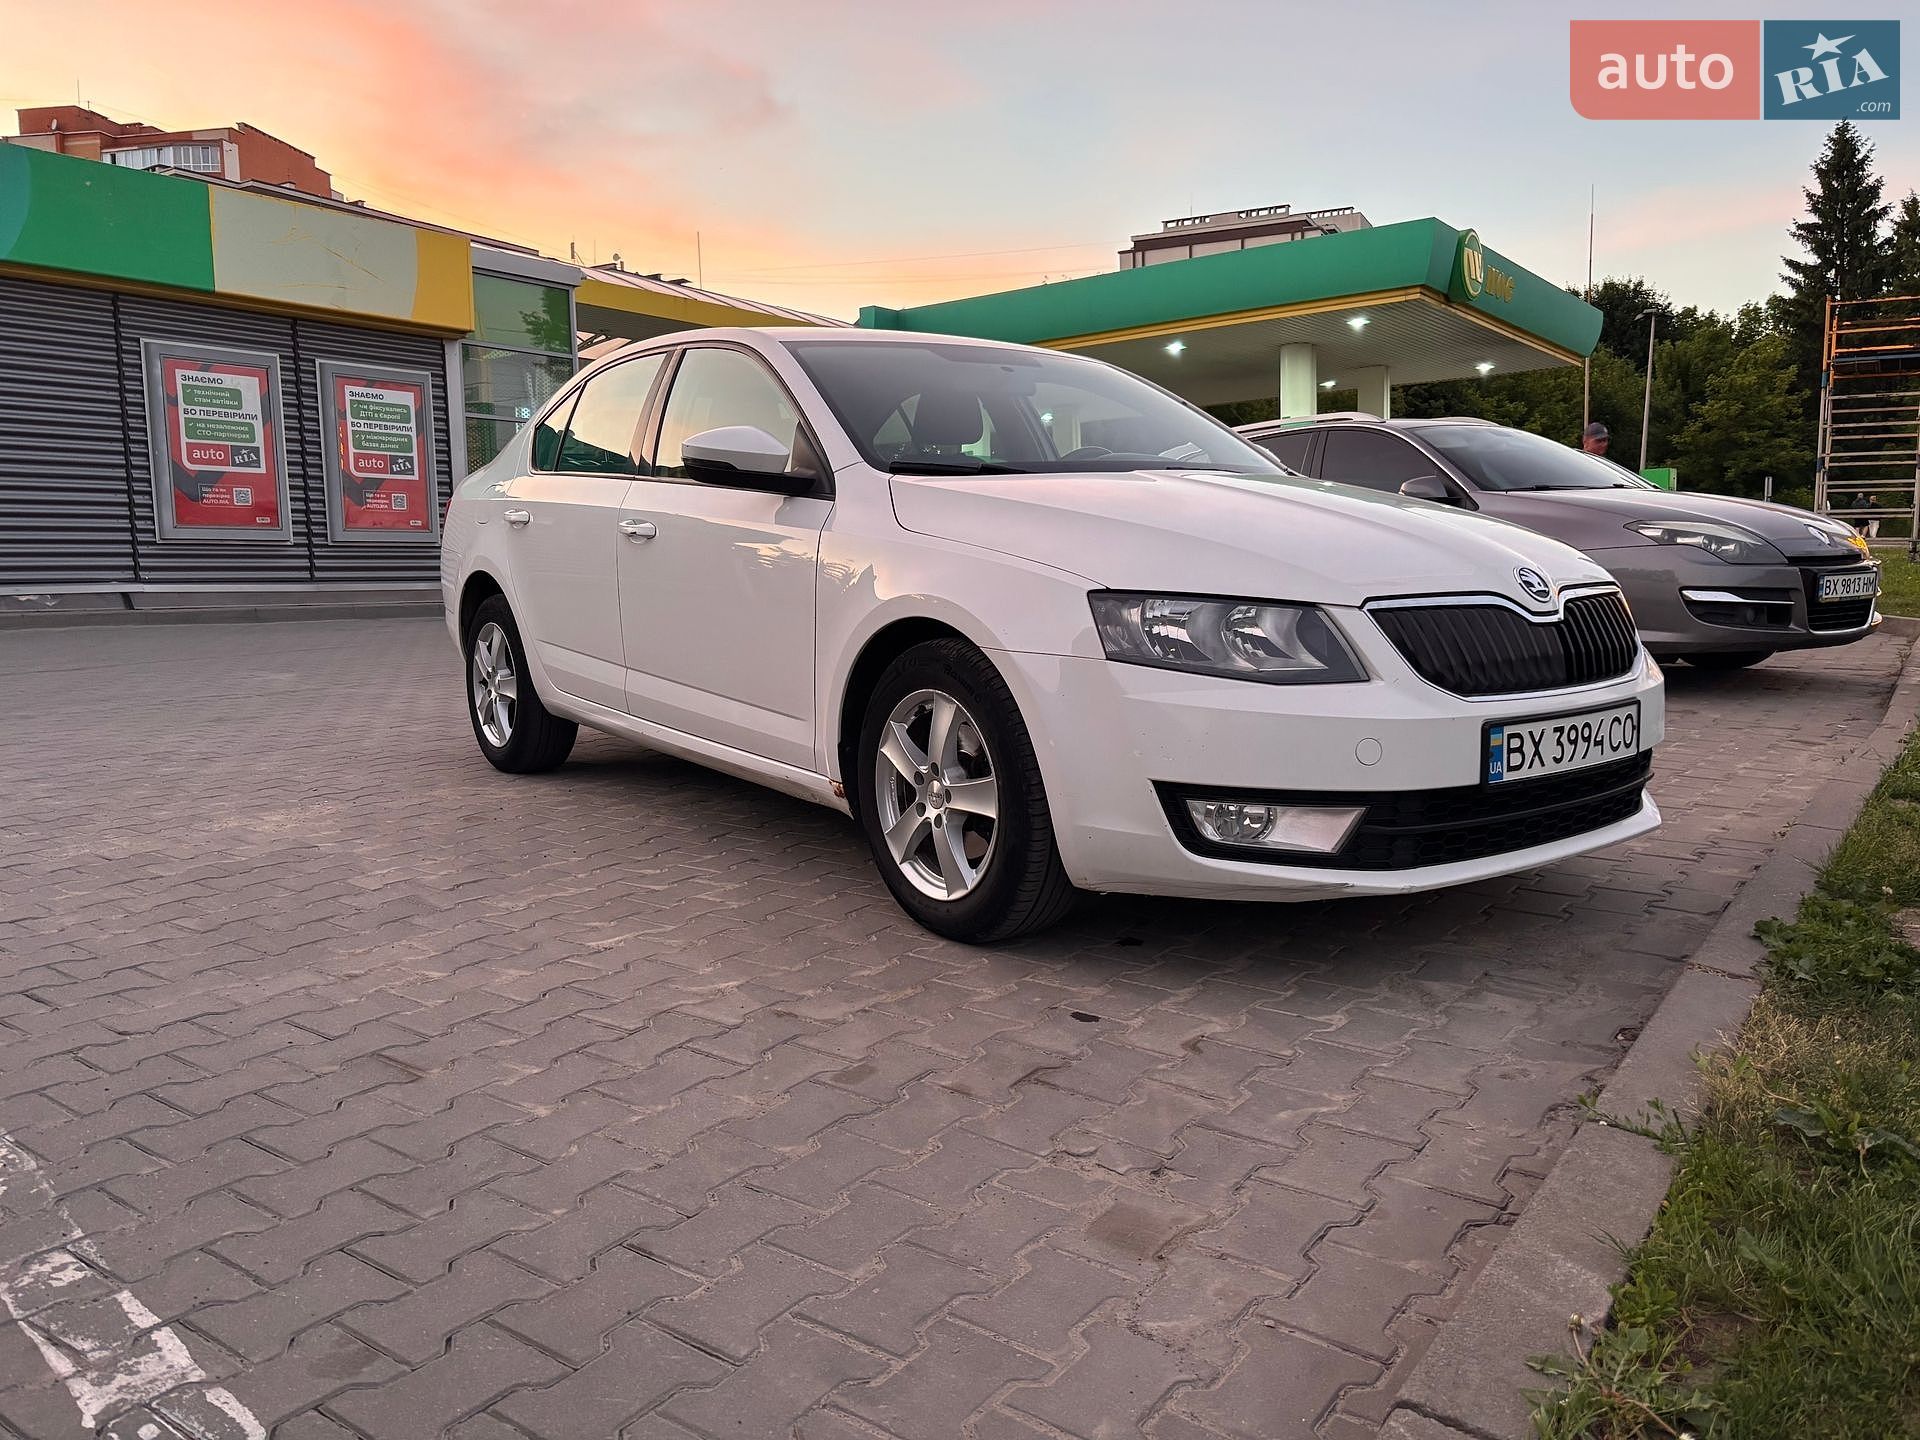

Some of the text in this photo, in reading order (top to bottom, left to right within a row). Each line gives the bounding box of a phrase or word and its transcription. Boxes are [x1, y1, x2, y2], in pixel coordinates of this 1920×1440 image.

[180, 374, 224, 385] ЗНАЄМО
[349, 390, 384, 400] ЗНАЄМО
[183, 407, 258, 421] БО ПЕРЕВІРИЛИ
[359, 410, 374, 418] ДТП
[363, 422, 413, 433] ПЕРЕВІРИЛИ
[192, 448, 225, 460] auto
[233, 452, 259, 464] RIA
[358, 458, 412, 472] auto RIA
[1825, 577, 1875, 596] BX 9813 HM
[1506, 712, 1636, 773] BX 3994 CO
[1489, 761, 1503, 774] UA
